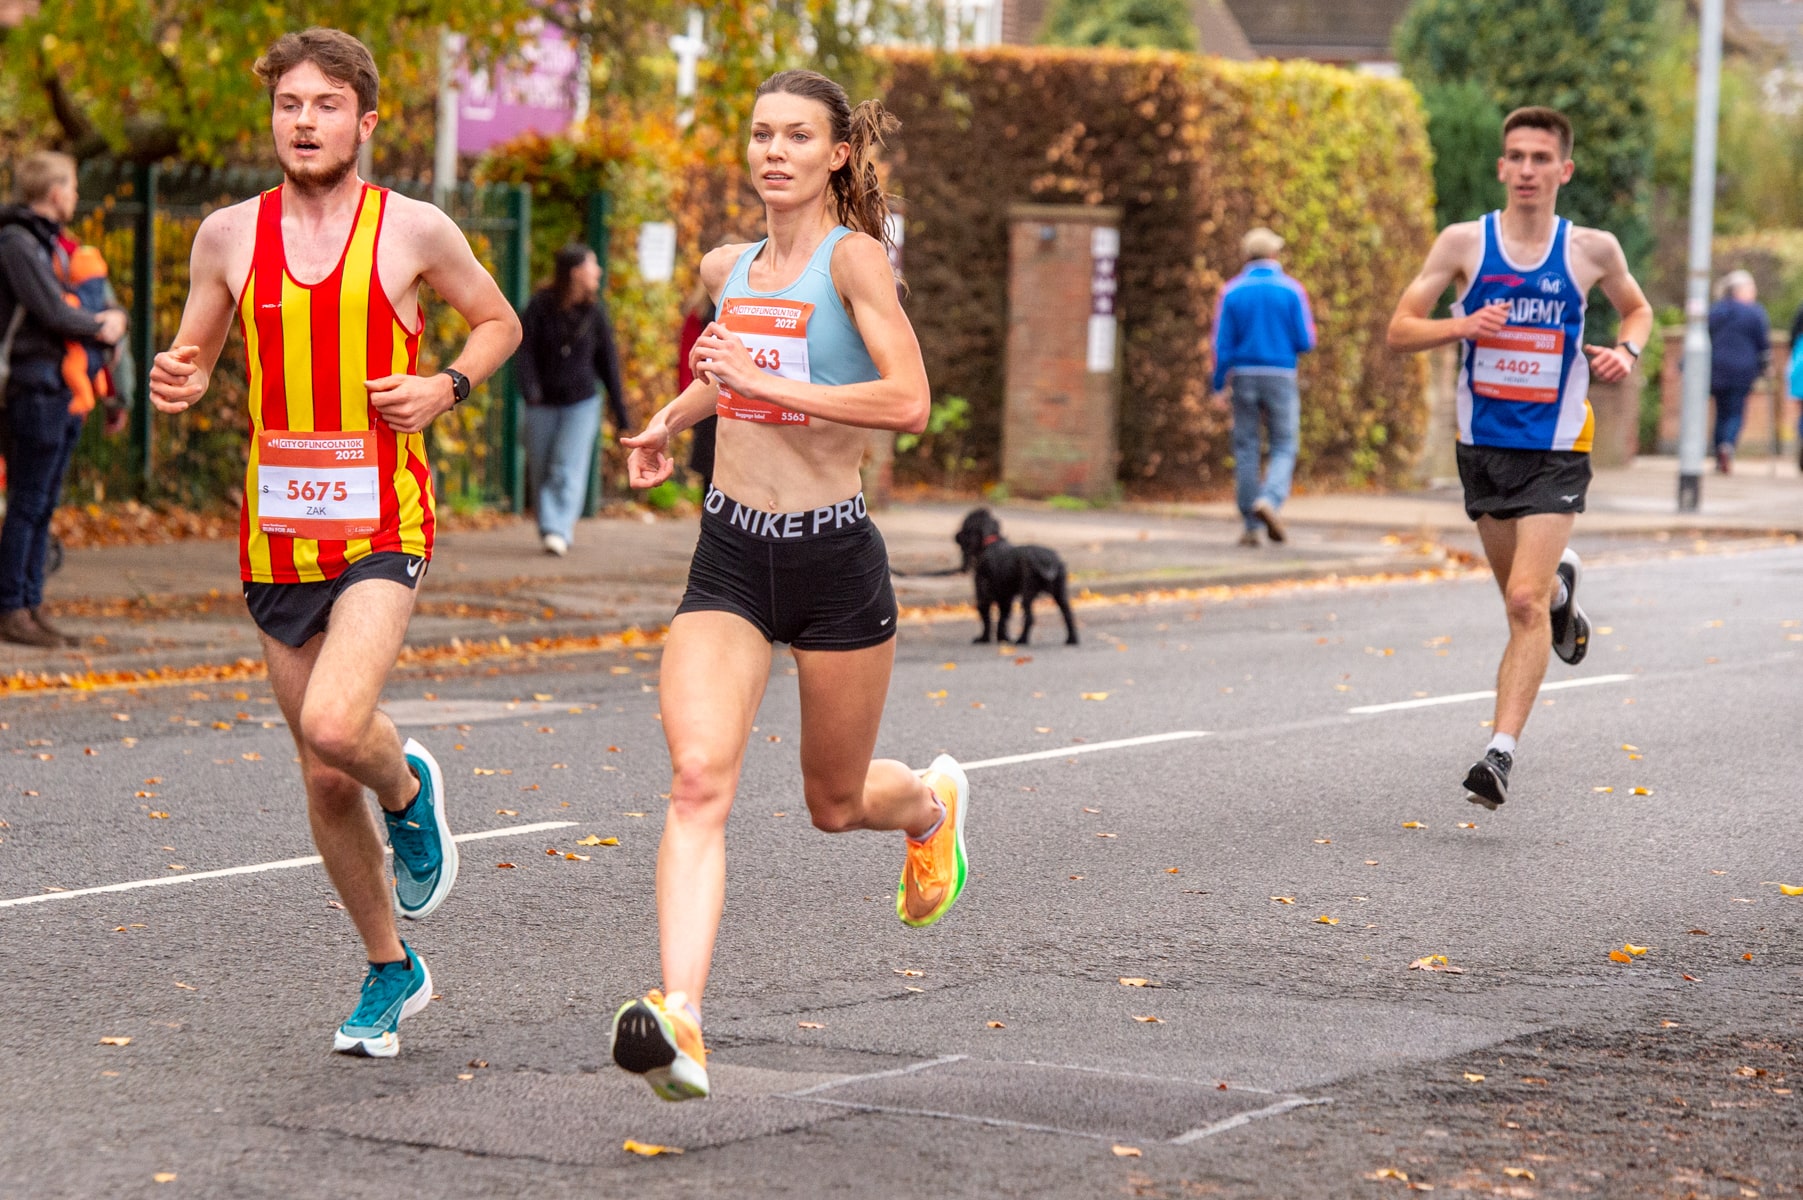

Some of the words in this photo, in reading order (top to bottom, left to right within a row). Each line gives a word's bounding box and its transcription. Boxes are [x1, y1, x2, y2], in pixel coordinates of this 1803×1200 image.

[774, 318, 798, 329] 2022
[1495, 358, 1541, 376] 4402
[781, 412, 806, 422] 5563
[335, 450, 365, 461] 2022
[262, 485, 270, 494] S
[287, 480, 348, 502] 5675
[306, 506, 327, 516] ZAK
[730, 502, 805, 538] NIKE
[813, 491, 867, 535] PRO
